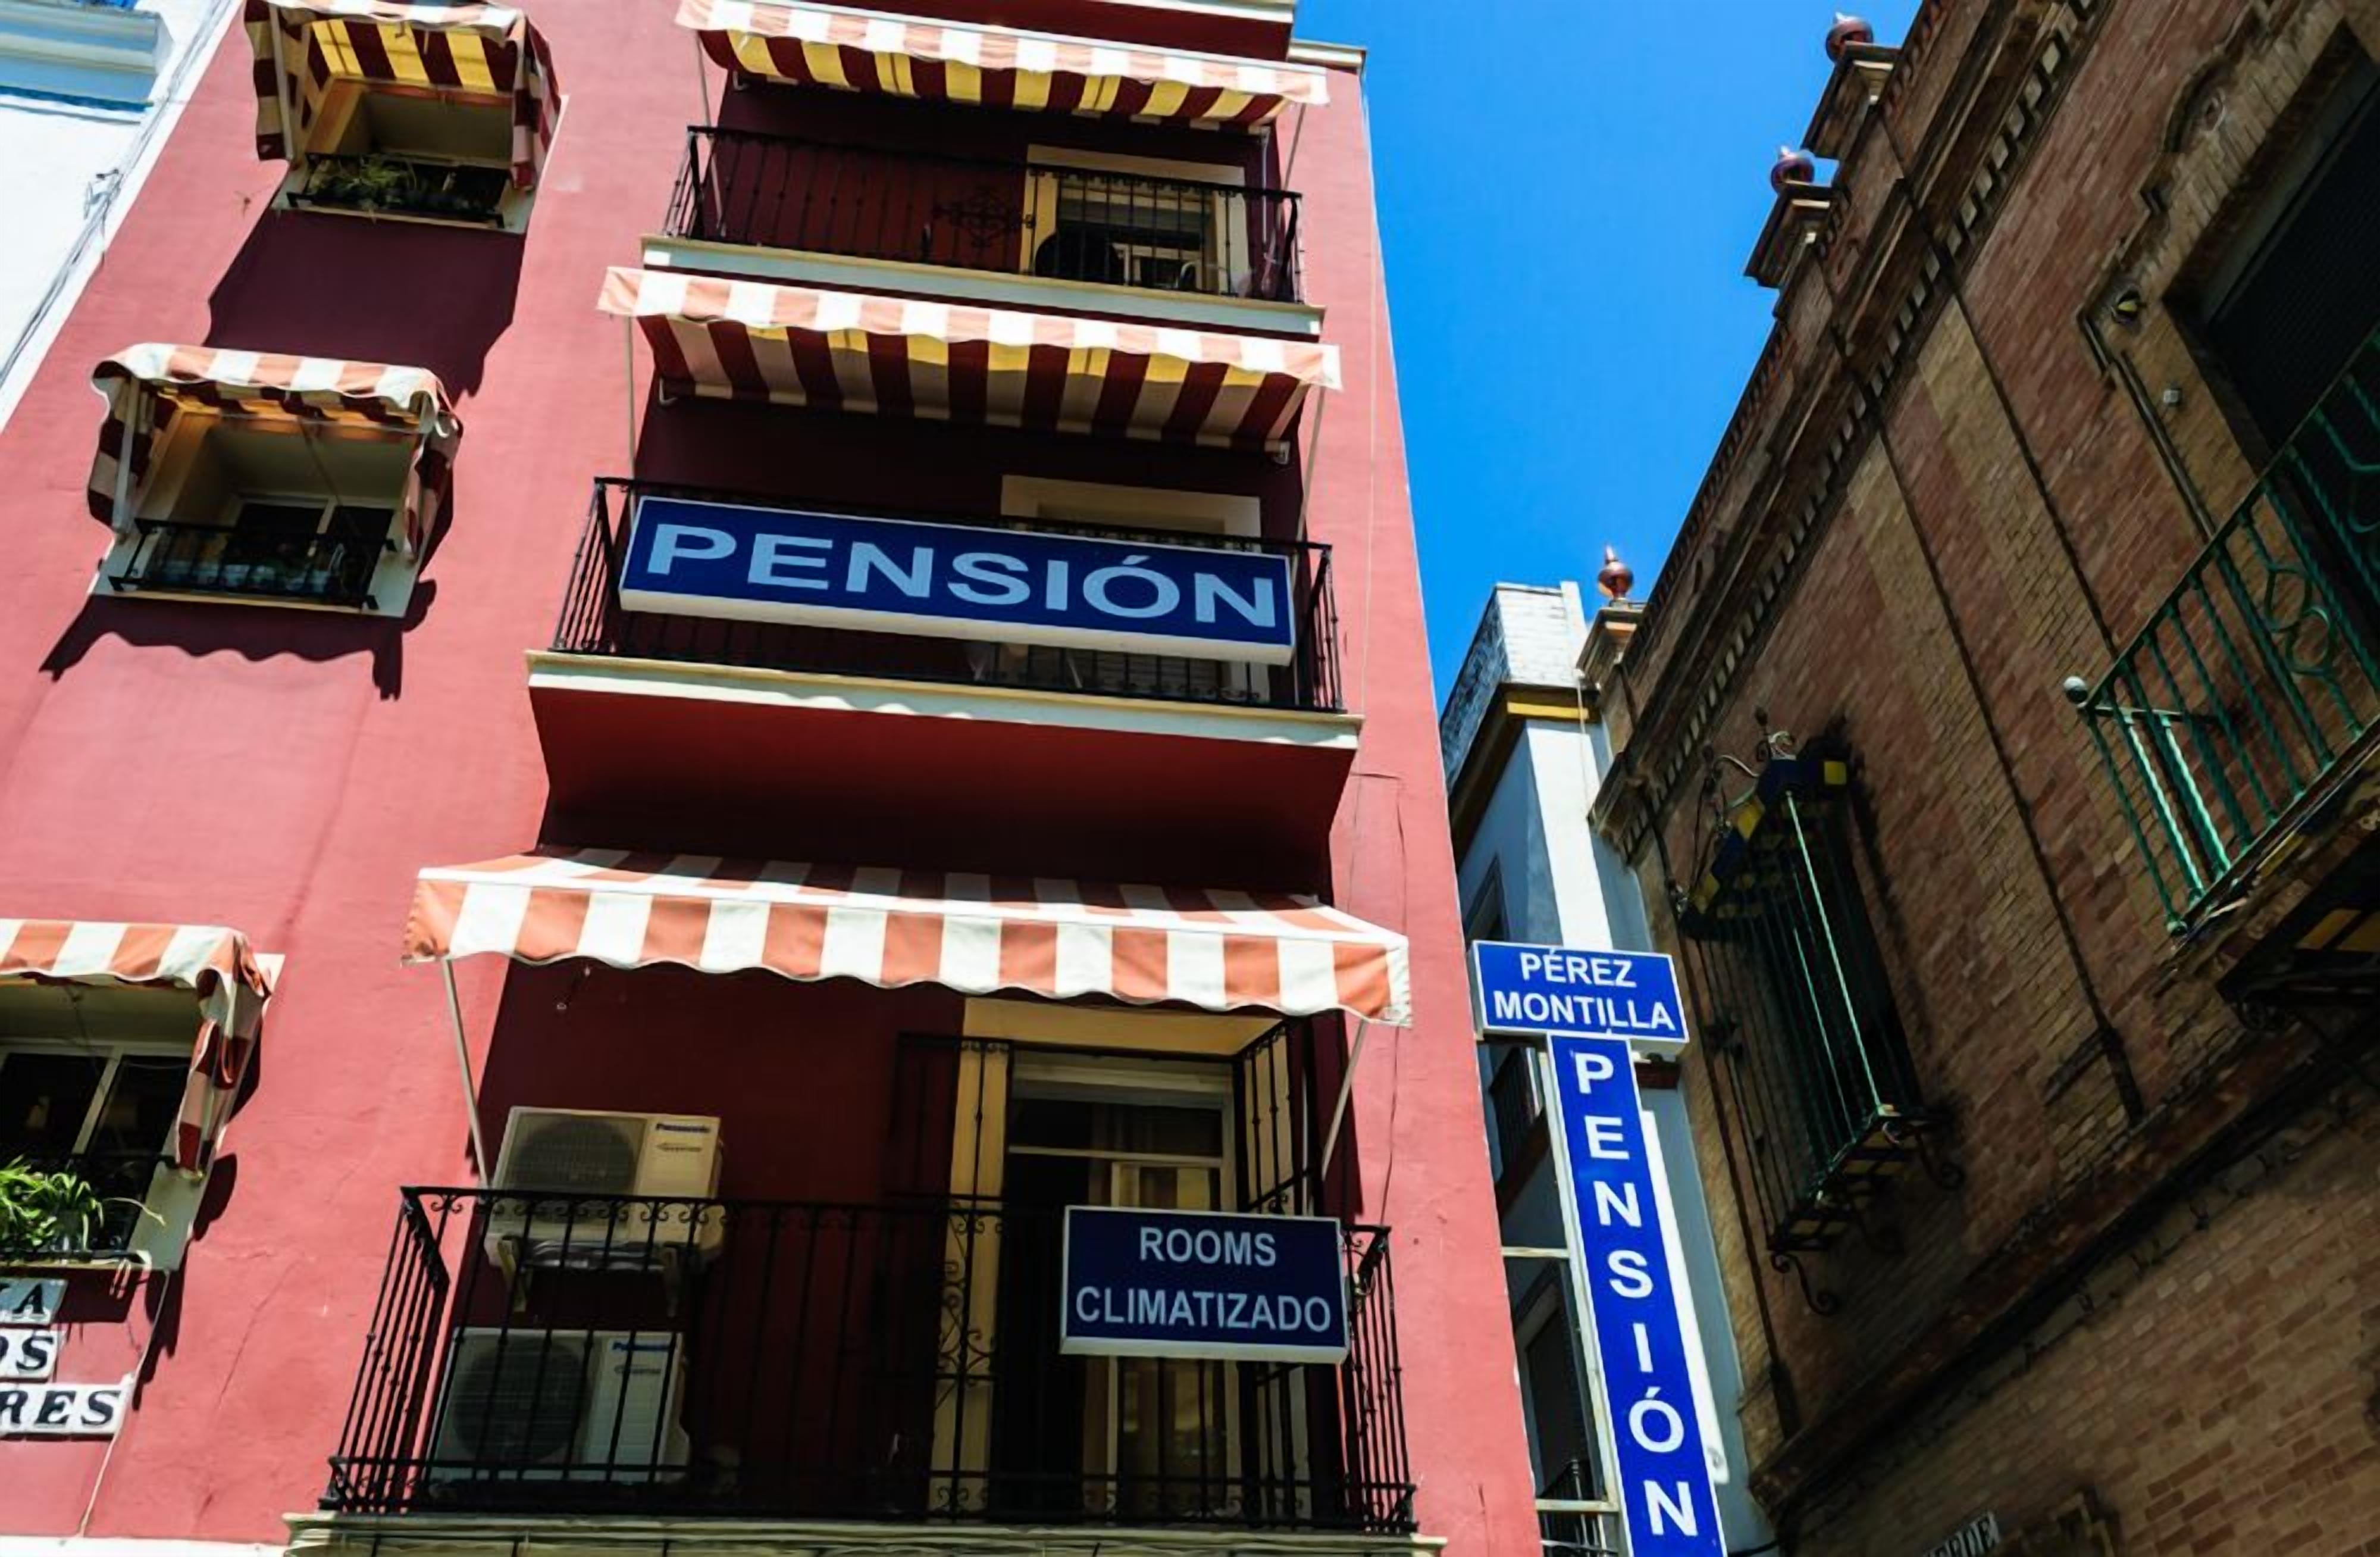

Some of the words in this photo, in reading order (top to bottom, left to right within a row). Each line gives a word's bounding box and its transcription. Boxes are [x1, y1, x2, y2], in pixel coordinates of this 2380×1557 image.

[646, 523, 1276, 628] PENSIÓN
[1520, 949, 1637, 988] PÉREZ
[1493, 990, 1677, 1031] MONTILLA
[1139, 1227, 1276, 1267] ROOMS
[0, 1283, 45, 1314] A
[1076, 1286, 1331, 1332] CLIMATIZADO
[1574, 1052, 1699, 1537] PENSIÓN
